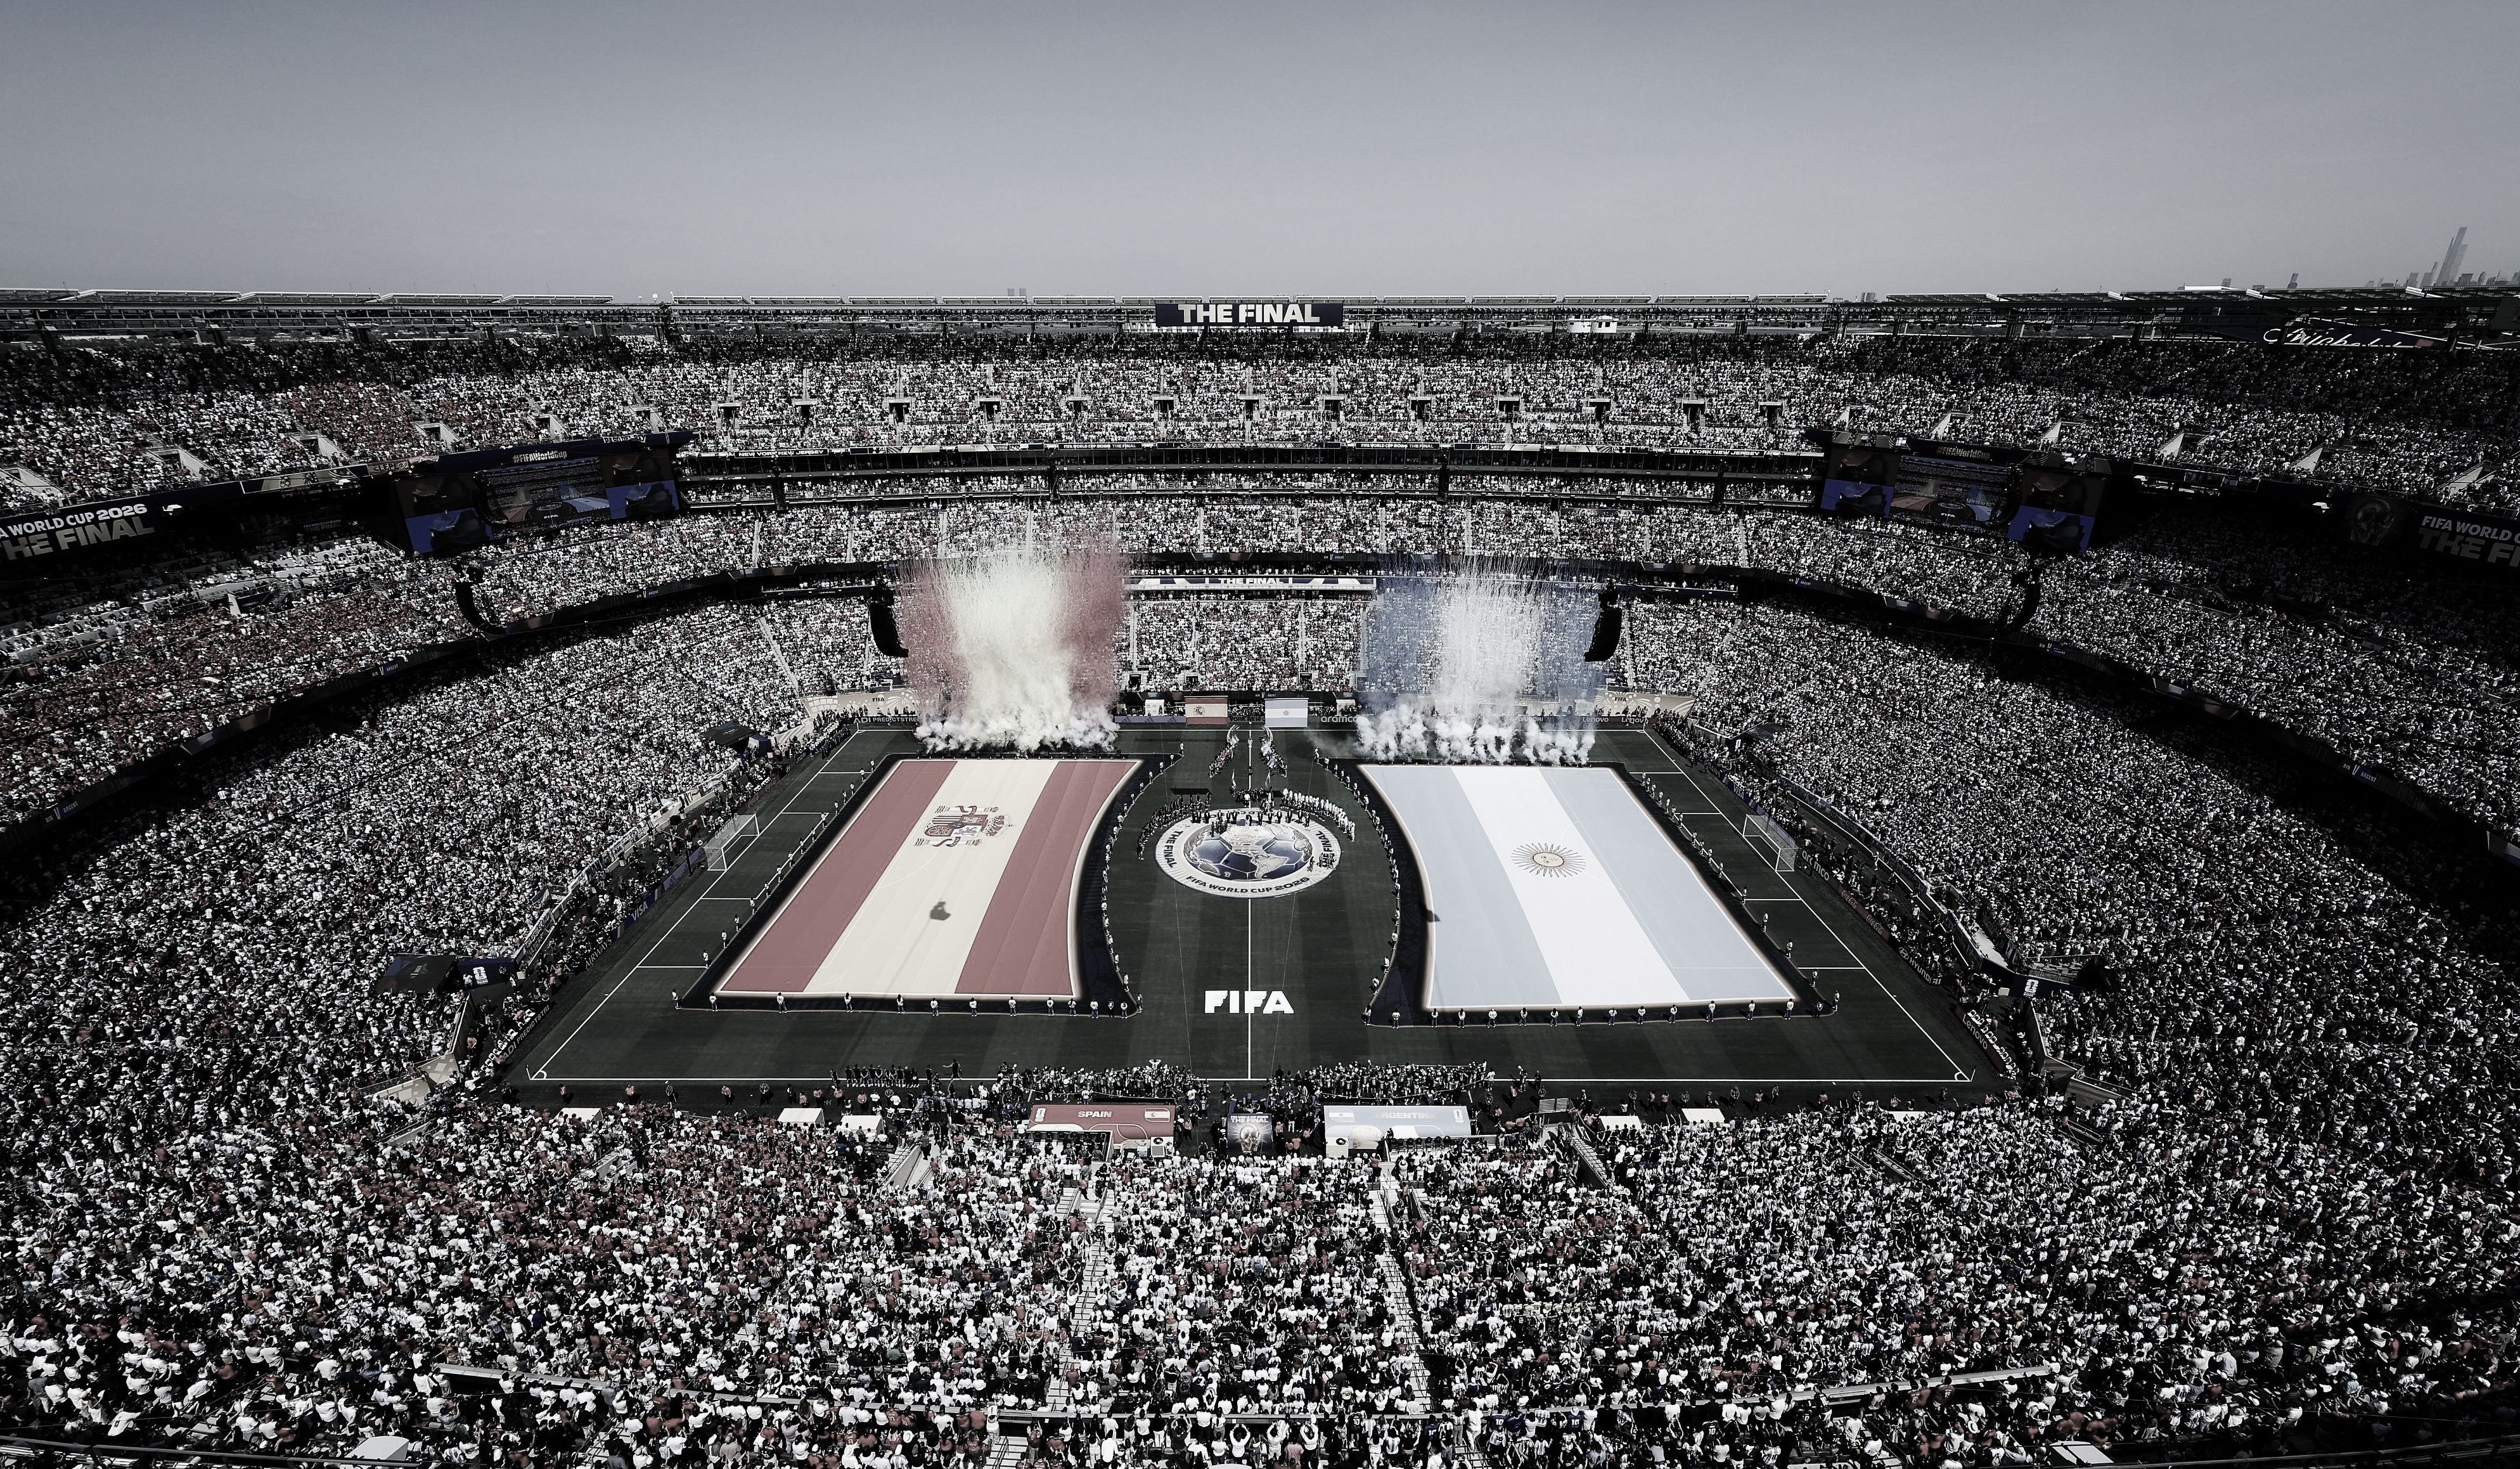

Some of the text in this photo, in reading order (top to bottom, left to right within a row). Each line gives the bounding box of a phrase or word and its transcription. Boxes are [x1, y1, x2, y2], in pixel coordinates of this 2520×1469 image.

[1178, 304, 1320, 323] THE FINAL
[512, 450, 568, 463] #FIFAWorldCup
[1936, 446, 1991, 461] #FIFAWorldCup
[7, 518, 65, 536] WORLD
[66, 512, 94, 526] CUP
[96, 503, 148, 521] 2026
[2421, 515, 2452, 531] FIFA
[2455, 521, 2512, 541] WORLD
[0, 516, 156, 561] HE FINAL
[2419, 527, 2486, 560] THE
[1733, 784, 1744, 800] VISA
[53, 806, 61, 820] V
[1164, 830, 1183, 867] THE FINAL
[1317, 831, 1331, 851] FINAL
[1186, 876, 1207, 887] FIFA
[1209, 884, 1248, 893] WORLD
[1275, 877, 1310, 891] 2026
[630, 901, 648, 921] VISA
[586, 936, 612, 970] AIRWAYS
[1909, 957, 1942, 985] HYUNDAI
[1204, 990, 1294, 1014] FIFA
[1962, 1013, 1988, 1050] Lenovo
